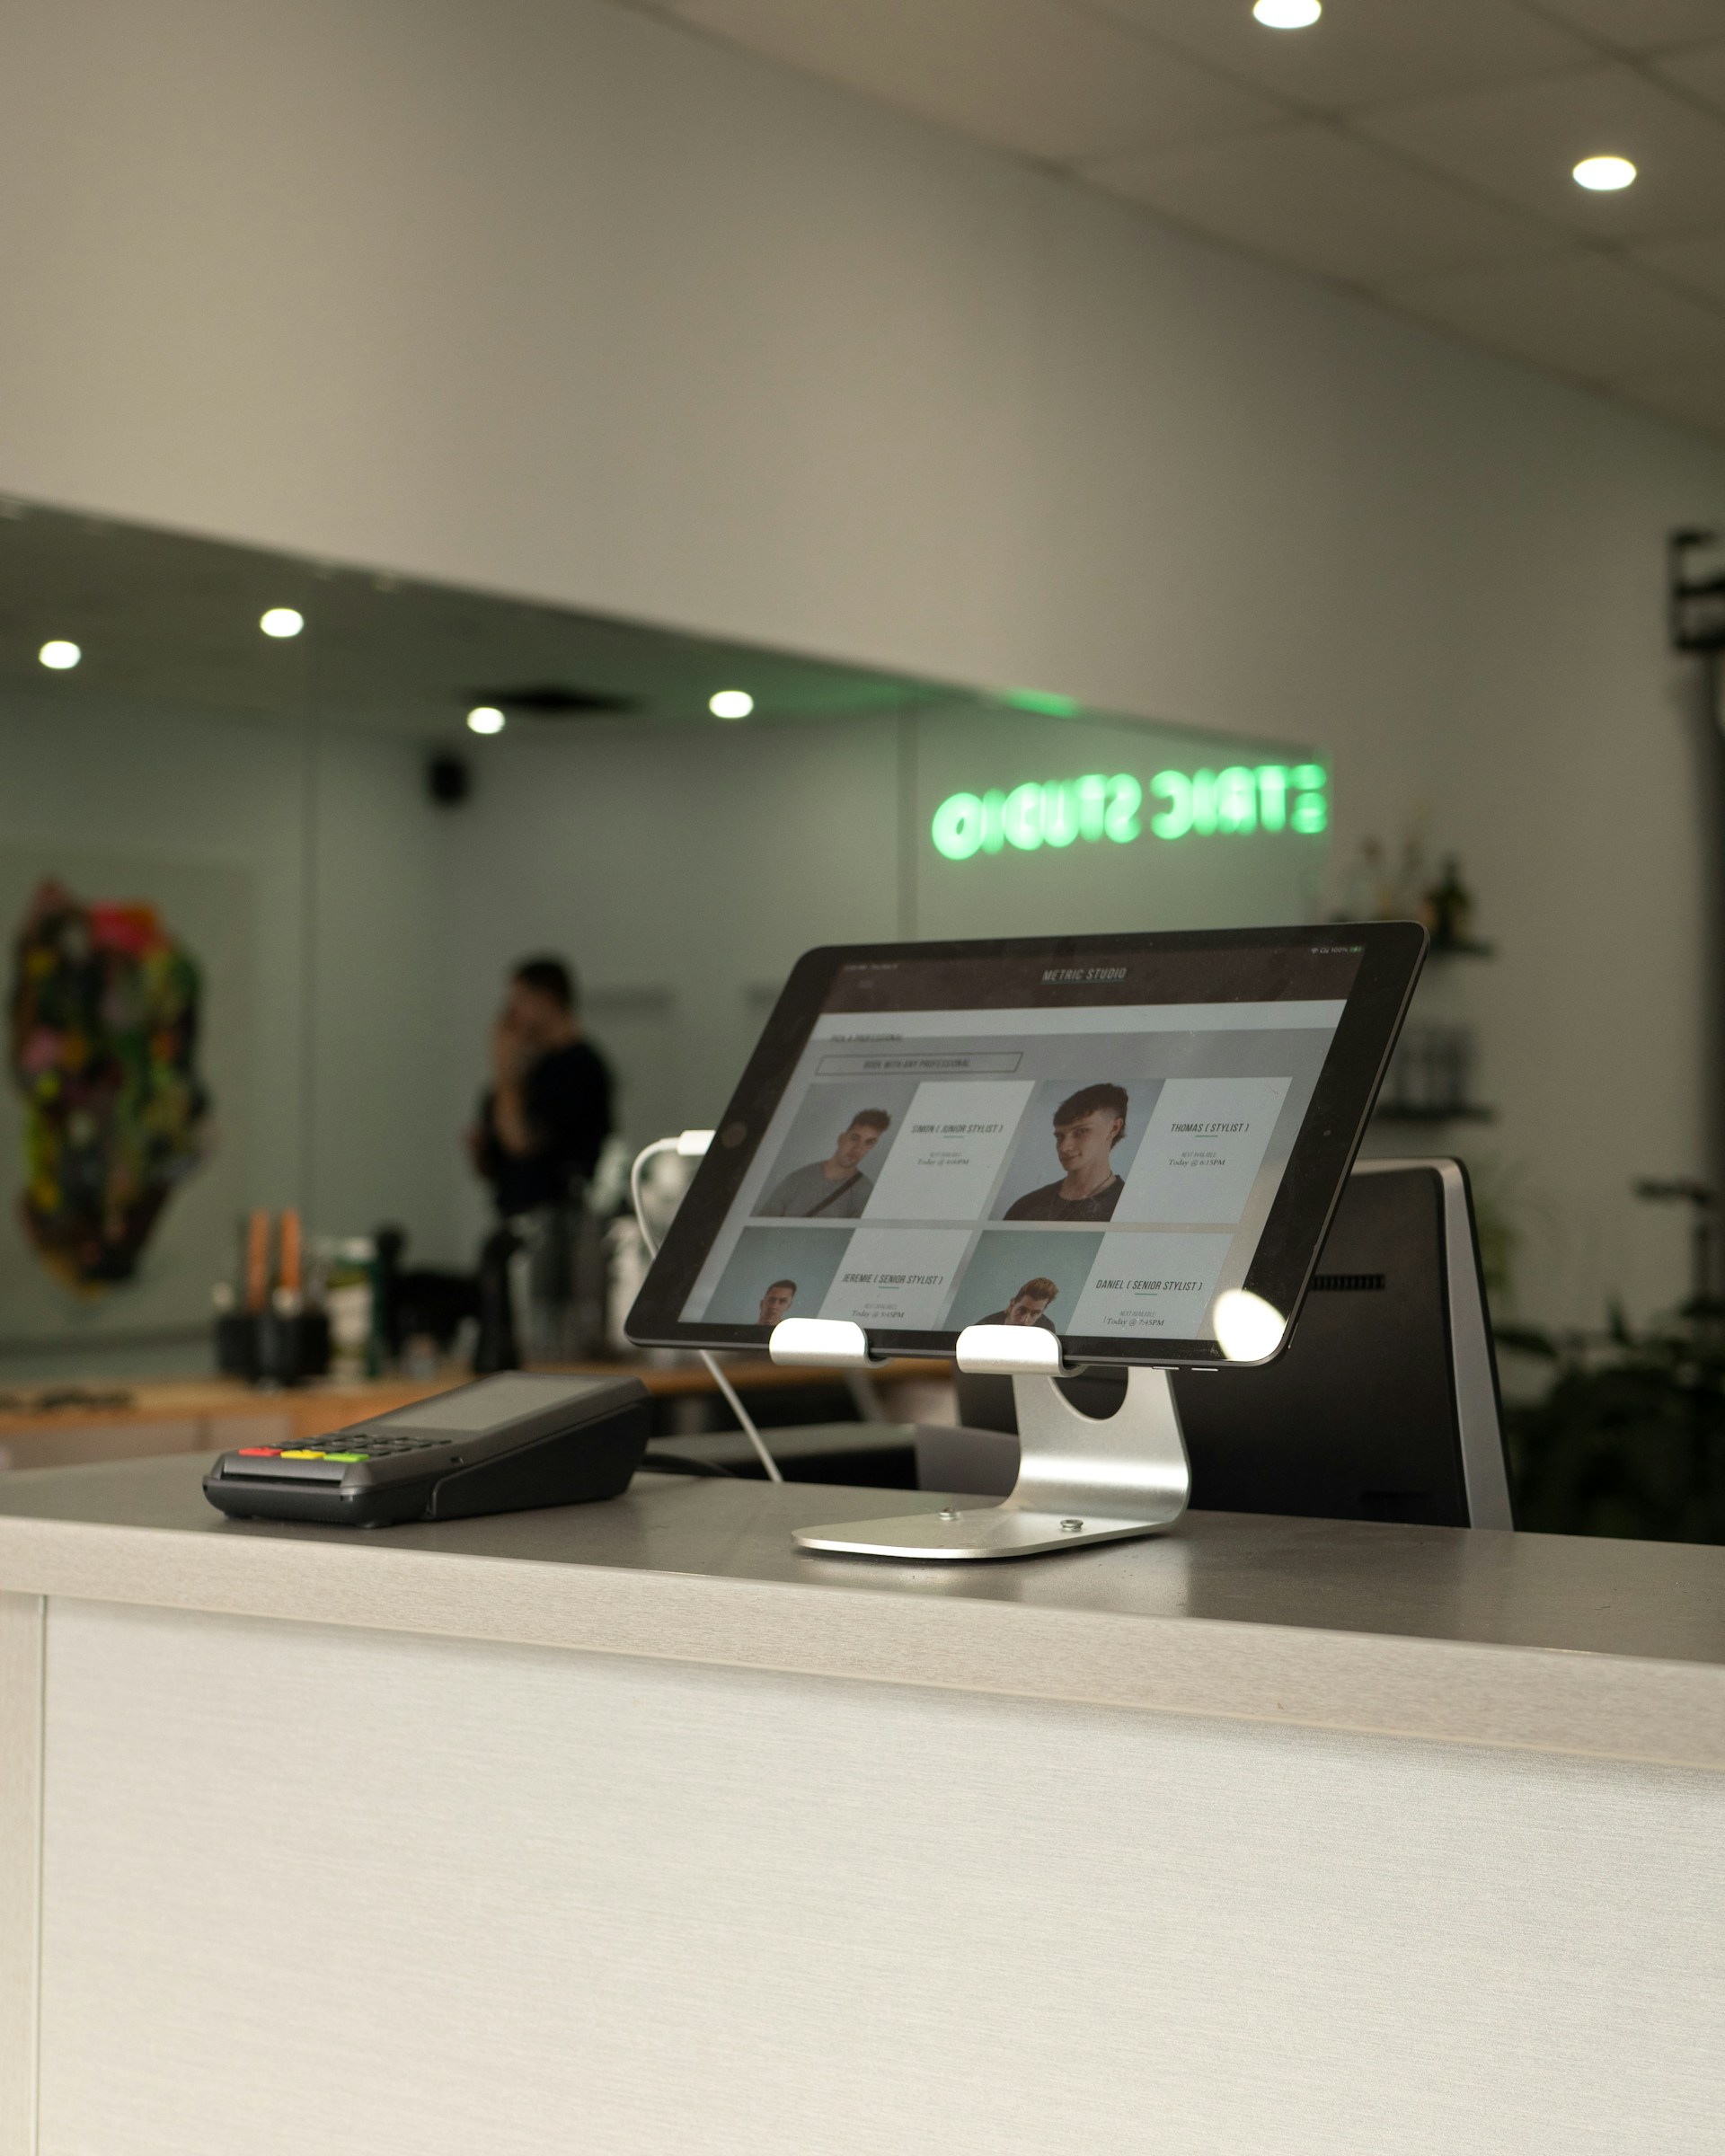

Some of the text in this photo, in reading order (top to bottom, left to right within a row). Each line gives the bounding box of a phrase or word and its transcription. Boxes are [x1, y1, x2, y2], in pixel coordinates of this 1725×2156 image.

[1041, 967, 1128, 981] METRIC STUDIO
[911, 1125, 935, 1133] SIMON
[941, 1124, 967, 1133] JUNIOR
[967, 1124, 998, 1133] STYLIST
[1171, 1123, 1204, 1133] THOMAS
[1210, 1123, 1244, 1133] STYLIST
[1169, 1159, 1189, 1168] Today
[1190, 1159, 1199, 1167] @
[842, 1273, 873, 1283] JEREMIE
[879, 1274, 906, 1284] SENIOR
[907, 1275, 938, 1285] STYLIST
[1095, 1279, 1124, 1289] DANIEL
[1132, 1280, 1162, 1290] SENIOR
[1163, 1281, 1198, 1291] STYLIST
[852, 1310, 870, 1318] Today
[1106, 1318, 1165, 1327] Today @ 7:45PM
